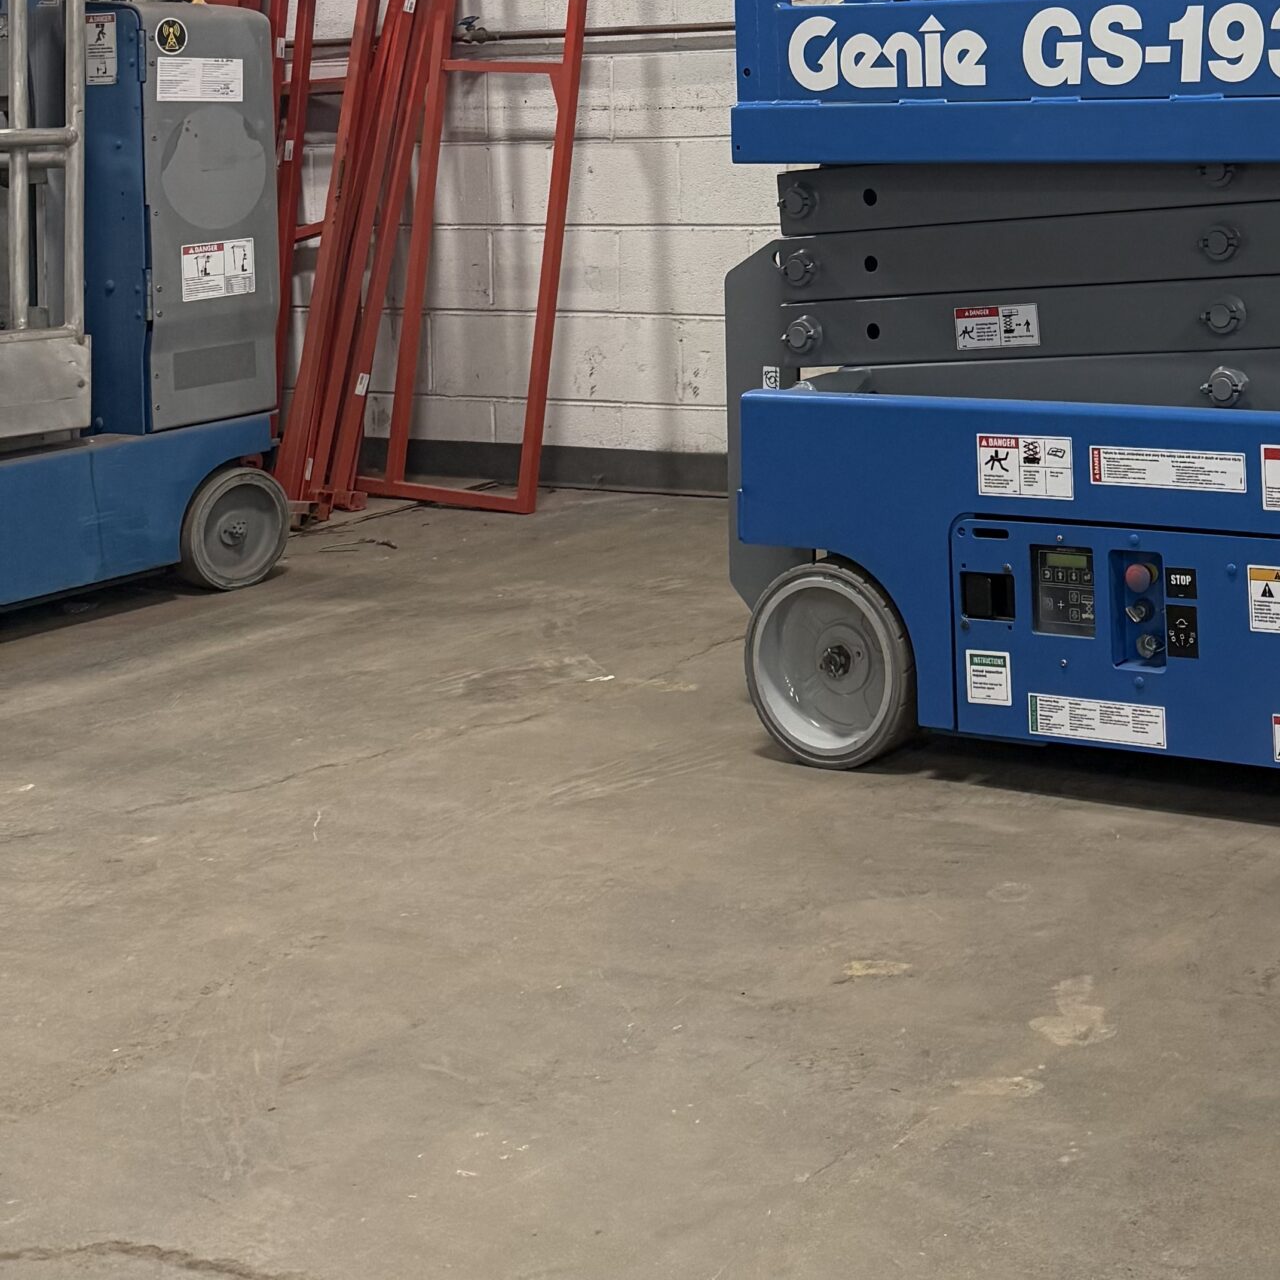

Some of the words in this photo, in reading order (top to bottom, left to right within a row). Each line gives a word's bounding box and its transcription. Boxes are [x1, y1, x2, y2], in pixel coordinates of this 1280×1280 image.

[788, 14, 988, 92] Genie
[195, 245, 218, 253] DANGER
[988, 438, 1016, 447] DANGER
[1170, 574, 1192, 586] STOP
